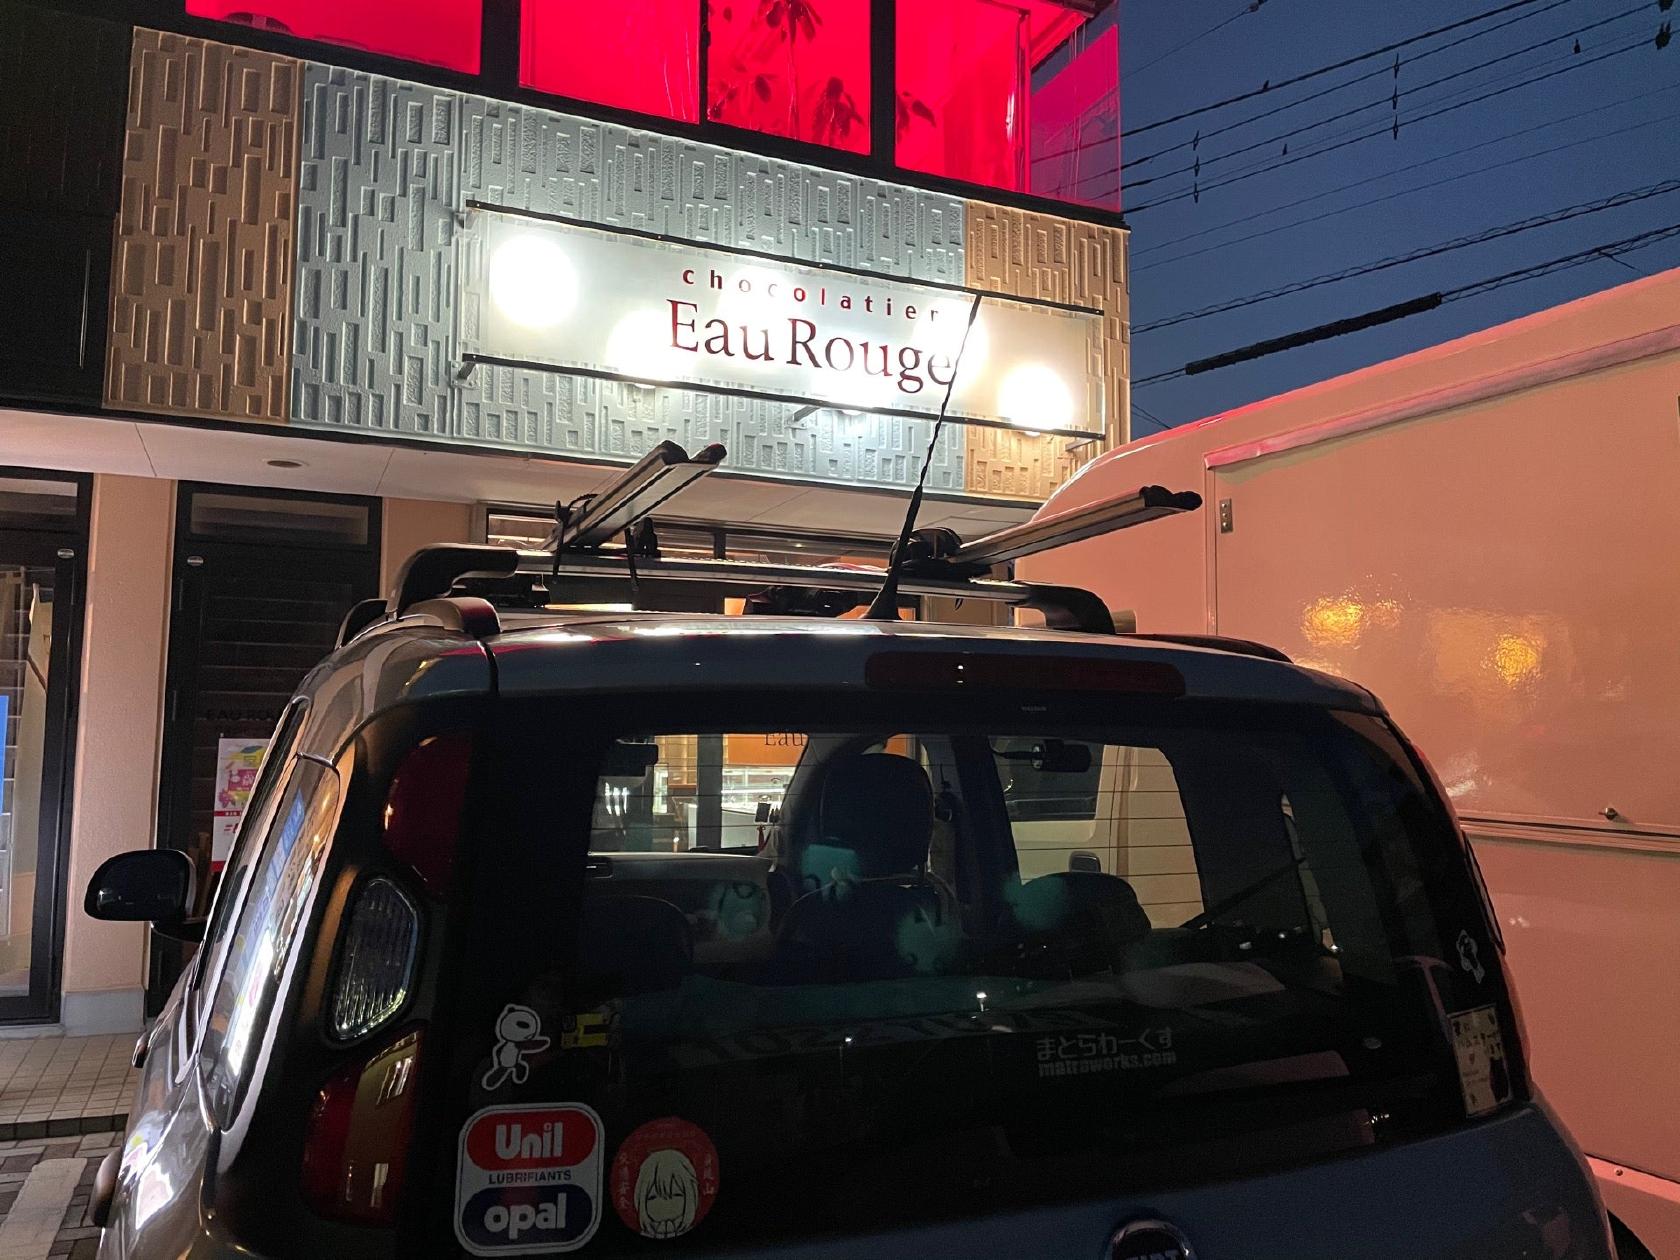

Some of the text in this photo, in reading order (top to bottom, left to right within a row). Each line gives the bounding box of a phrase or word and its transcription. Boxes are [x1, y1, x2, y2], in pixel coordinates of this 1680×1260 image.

[682, 269, 939, 322] chocolatier
[666, 298, 954, 395] Eau Rouge
[1036, 1026, 1174, 1061] まとらわーくす
[495, 1121, 564, 1161] Unil
[488, 1169, 572, 1185] LUBRIFIANTS
[483, 1192, 567, 1241] opal
